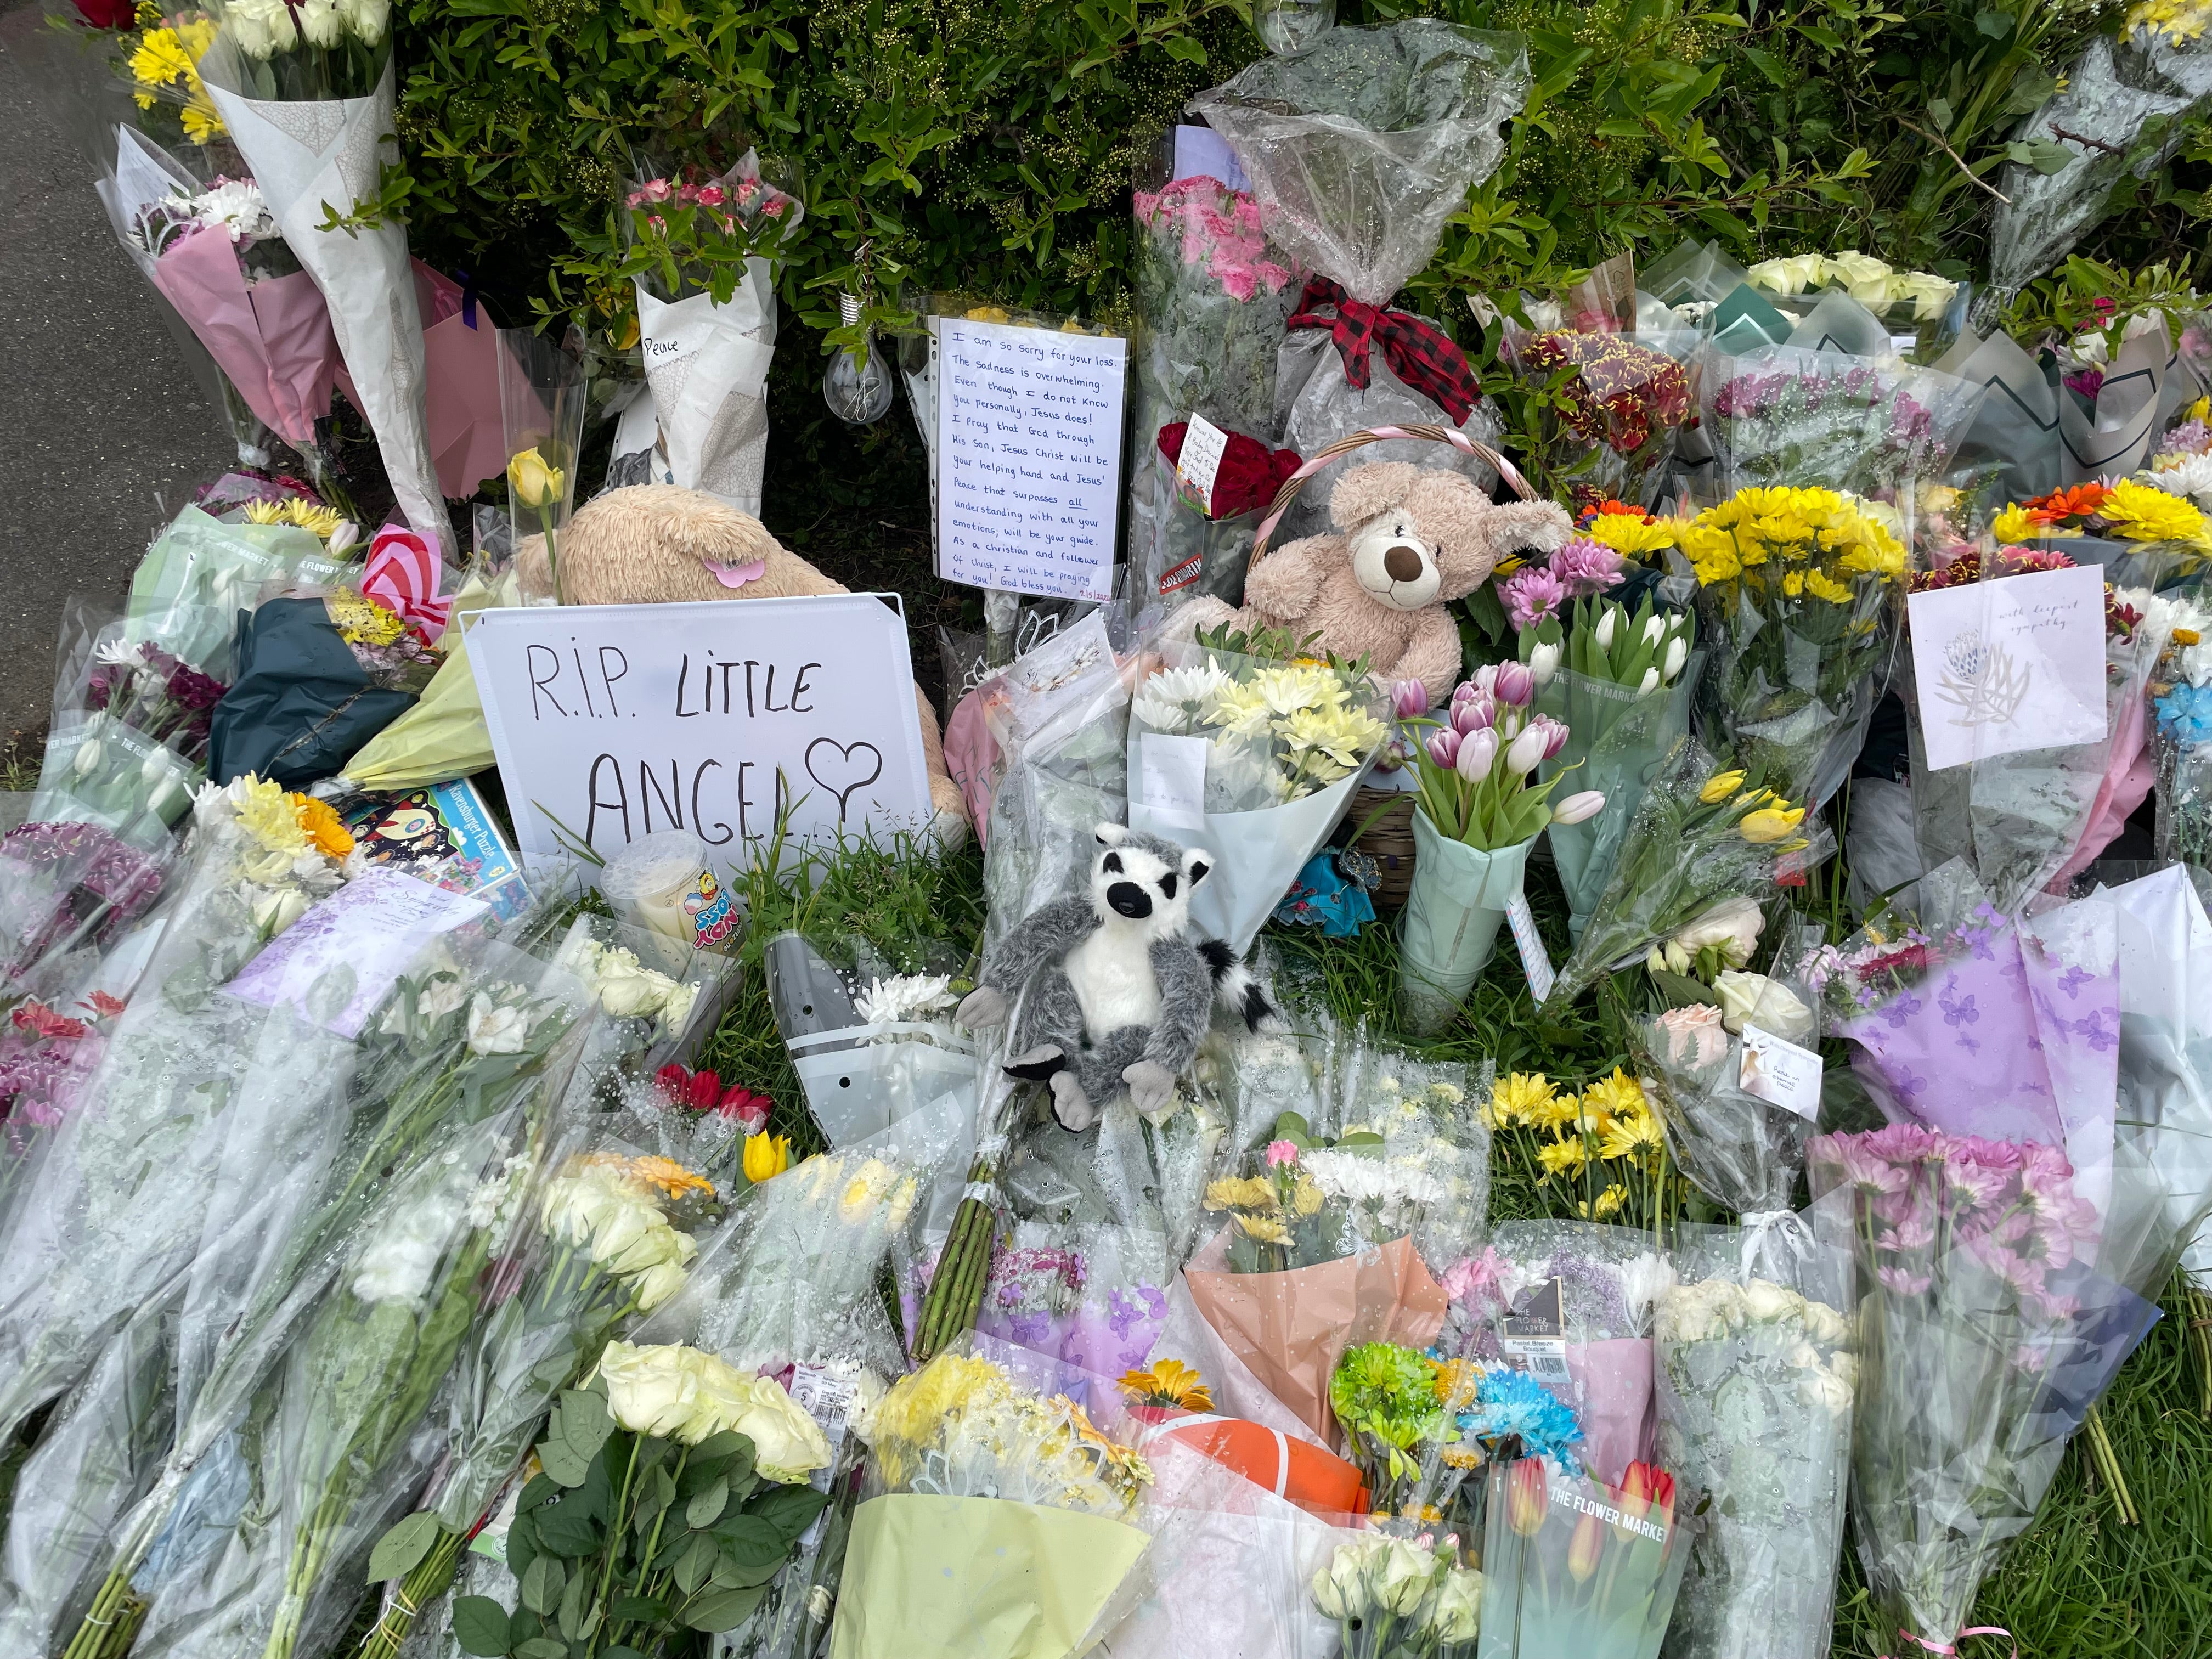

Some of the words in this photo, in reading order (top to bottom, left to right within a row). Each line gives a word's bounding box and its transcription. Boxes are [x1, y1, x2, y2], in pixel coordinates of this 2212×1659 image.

[644, 338, 678, 356] Peace
[952, 332, 964, 341] I
[974, 337, 991, 347] am
[1051, 348, 1065, 360] for
[1070, 353, 1091, 367] your
[1096, 357, 1118, 368] loss.
[952, 354, 969, 367] The
[1021, 368, 1029, 377] is
[955, 375, 977, 388] Even
[988, 382, 1017, 399] though
[1043, 391, 1056, 402] do
[1060, 395, 1076, 404] not
[953, 394, 969, 407] you
[976, 399, 1027, 419] personally,
[1031, 408, 1060, 420] Jesus
[1065, 413, 1092, 426] does!
[997, 422, 1018, 433] that
[1029, 427, 1048, 438] God
[1057, 430, 1094, 447] through
[1188, 432, 1192, 441] A
[1192, 436, 1203, 454] Baby
[1203, 443, 1221, 460] Daniel
[952, 434, 966, 445] His
[1001, 444, 1028, 456] Jesus
[1036, 448, 1064, 461] Christ
[1071, 454, 1091, 464] will
[1096, 456, 1108, 466] be
[953, 455, 972, 469] your
[980, 460, 1015, 478] helping
[1020, 466, 1043, 479] hand
[1050, 472, 1069, 482] and
[1076, 473, 1104, 486] Jesus'
[984, 486, 1006, 496] that
[1013, 490, 1058, 504] surpasses
[1069, 498, 1082, 507] all
[955, 500, 1022, 523] understanding
[1030, 511, 1053, 521] with
[1060, 515, 1074, 524] all
[1079, 520, 1099, 529] your
[1004, 529, 1022, 538] will
[1029, 530, 1041, 539] be
[1045, 534, 1064, 544] your
[1070, 535, 1098, 547] guide.
[953, 537, 964, 545] As
[1036, 549, 1054, 559] and
[1061, 552, 1098, 566] follower
[306, 561, 334, 574] FLOWER
[1018, 565, 1037, 575] will
[1044, 569, 1054, 578] be
[1059, 573, 1090, 586] praying
[953, 569, 964, 579] for
[973, 573, 992, 585] you!
[1001, 576, 1018, 587] God
[1022, 579, 1044, 590] bless
[1047, 583, 1067, 594] you.
[1999, 608, 2024, 620] with
[2033, 599, 2078, 617] deepest
[2010, 618, 2066, 636] sympathy
[1554, 672, 1570, 685] THE
[1571, 676, 1601, 695] FLOWER
[120, 738, 134, 751] THE
[448, 783, 482, 834] Ravensburger
[473, 830, 495, 860] Puzzle
[696, 888, 732, 930] LOSS
[1517, 1324, 1548, 1333] MARKET
[801, 1392, 807, 1401] 5
[1550, 1485, 1571, 1508] THE
[1573, 1494, 1620, 1525] FLOWER
[1622, 1514, 1668, 1544] MARKET
